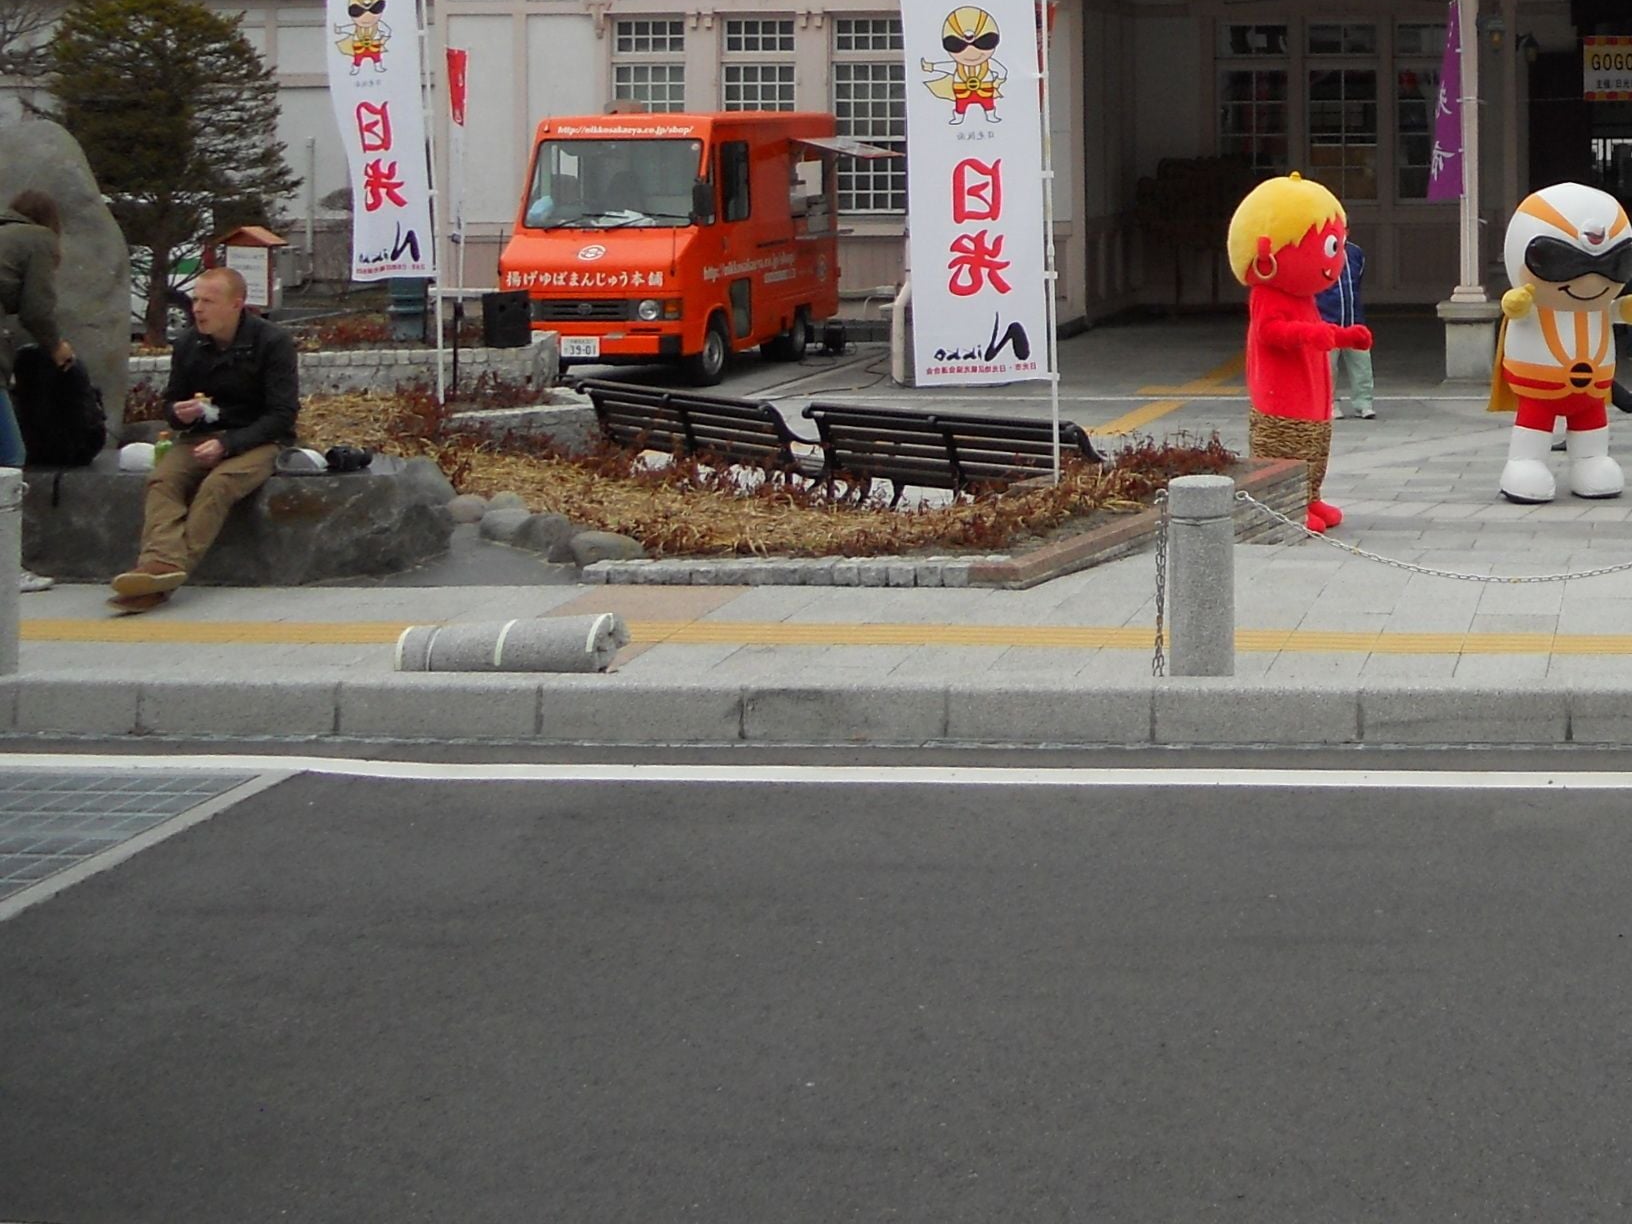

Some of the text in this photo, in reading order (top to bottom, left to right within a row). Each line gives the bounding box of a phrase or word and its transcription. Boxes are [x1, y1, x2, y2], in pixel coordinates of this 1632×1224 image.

[506, 269, 664, 288] 揚げゆばまんじゅう本舗
